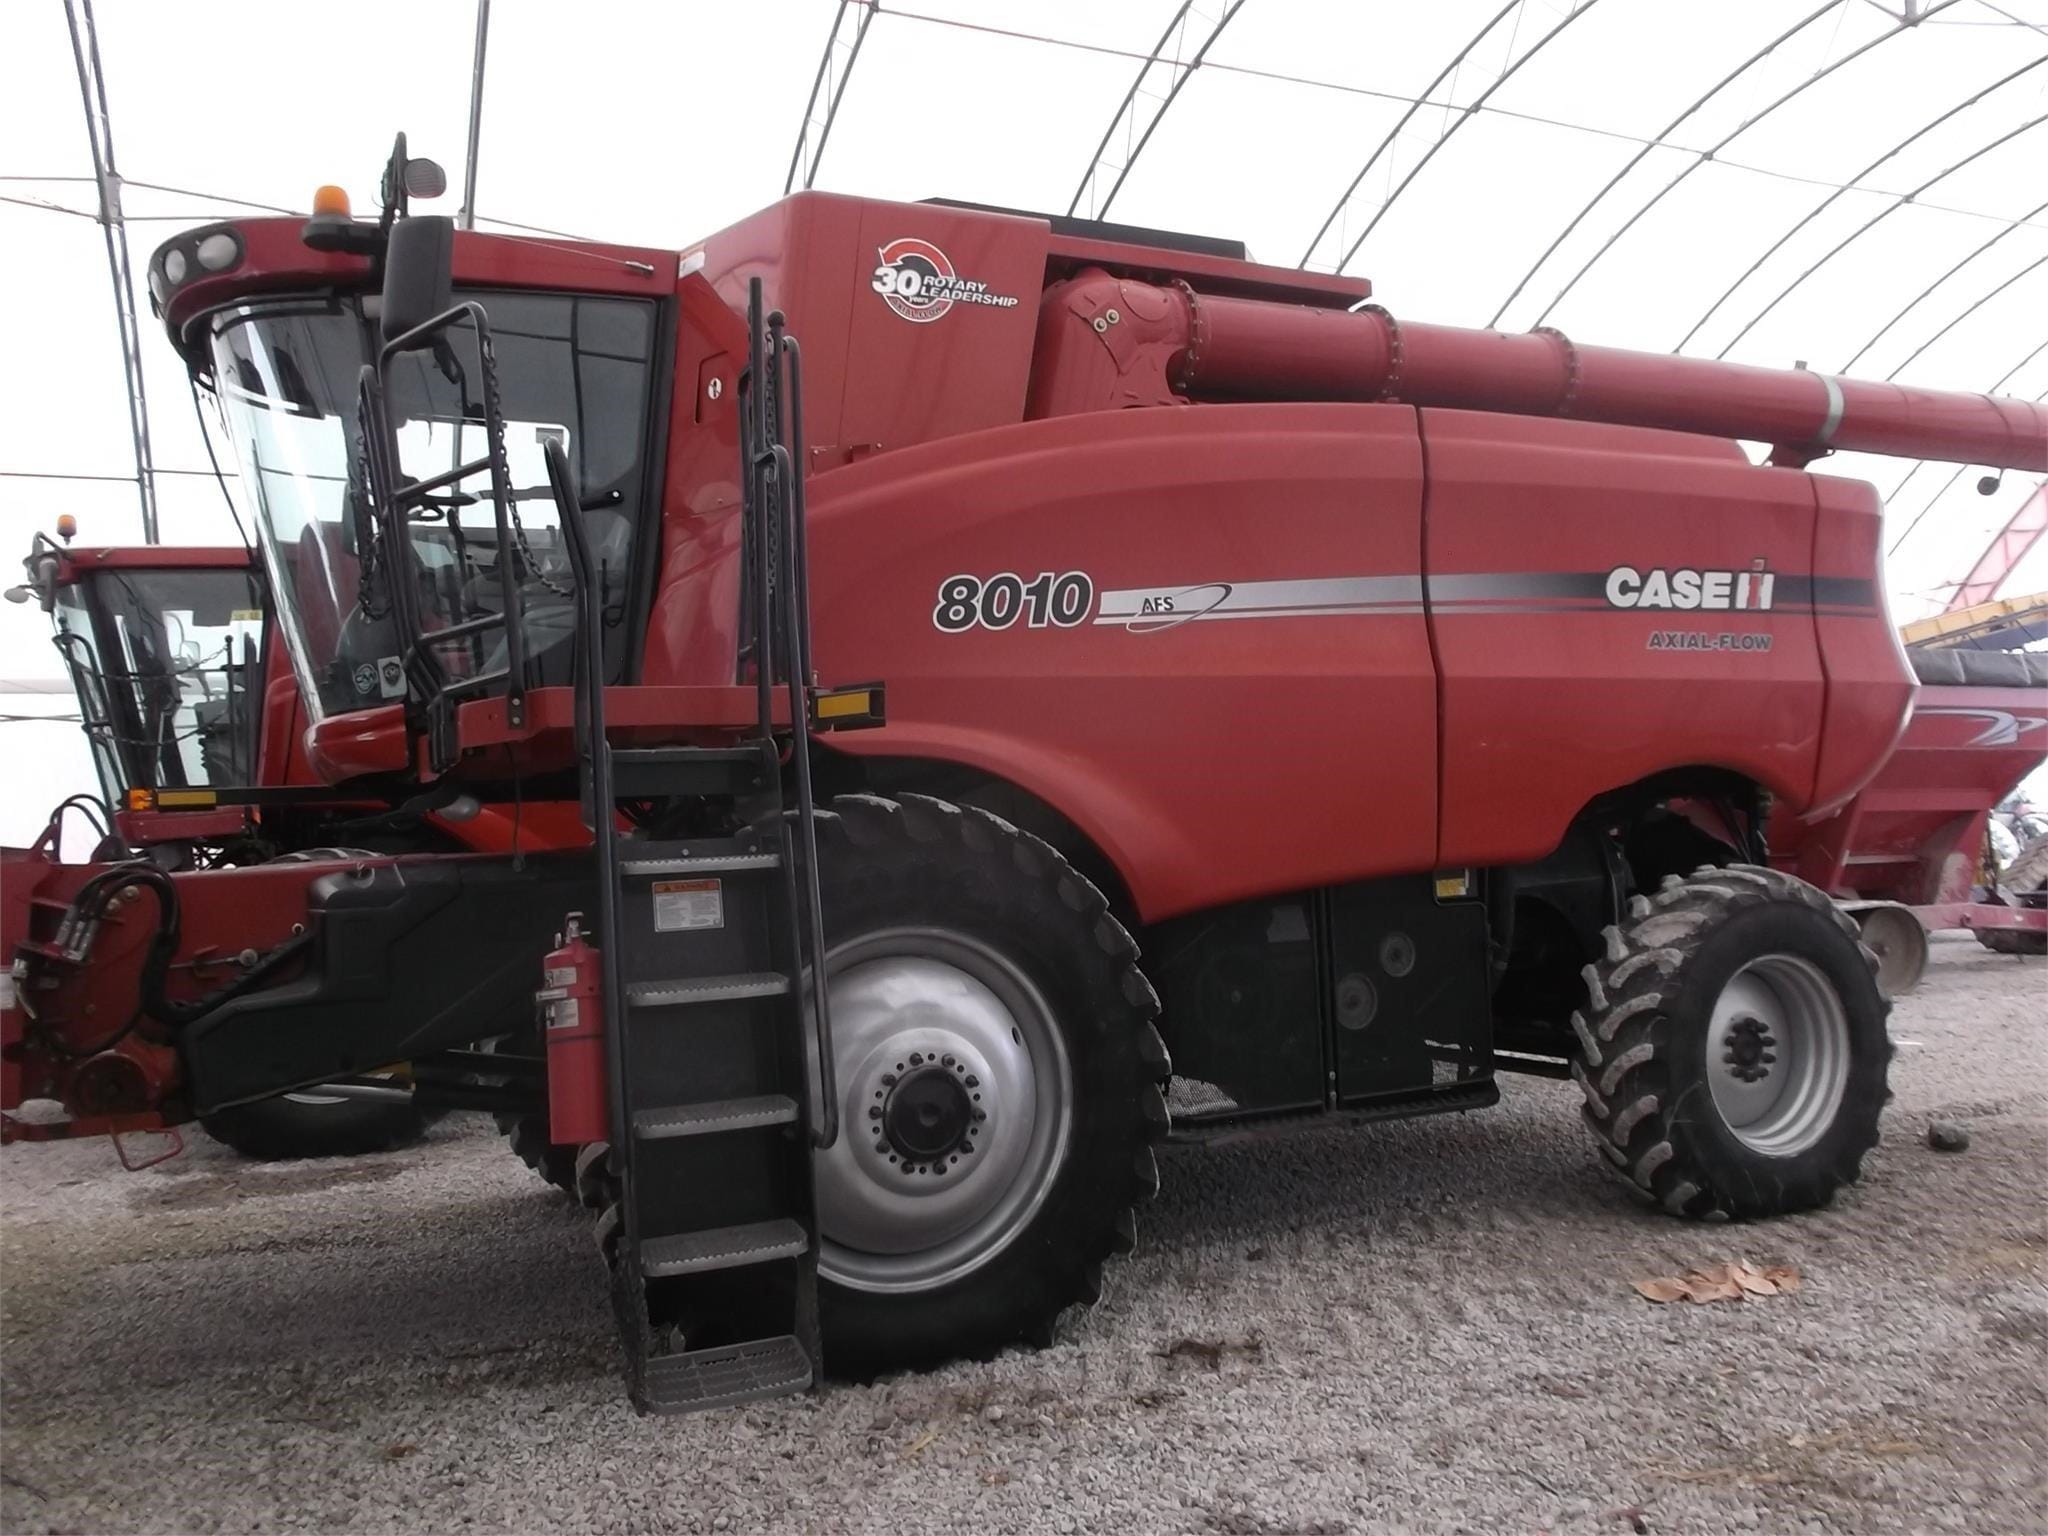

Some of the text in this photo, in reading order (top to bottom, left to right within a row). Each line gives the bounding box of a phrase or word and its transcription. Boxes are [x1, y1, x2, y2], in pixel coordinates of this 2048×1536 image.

[872, 266, 922, 296] 30
[923, 276, 987, 293] ROTARY
[920, 286, 1019, 308] LEADERSHIP
[933, 570, 1093, 633] 8010
[1142, 596, 1174, 615] AFS
[1647, 631, 1772, 653] AXIAL-FLOW
